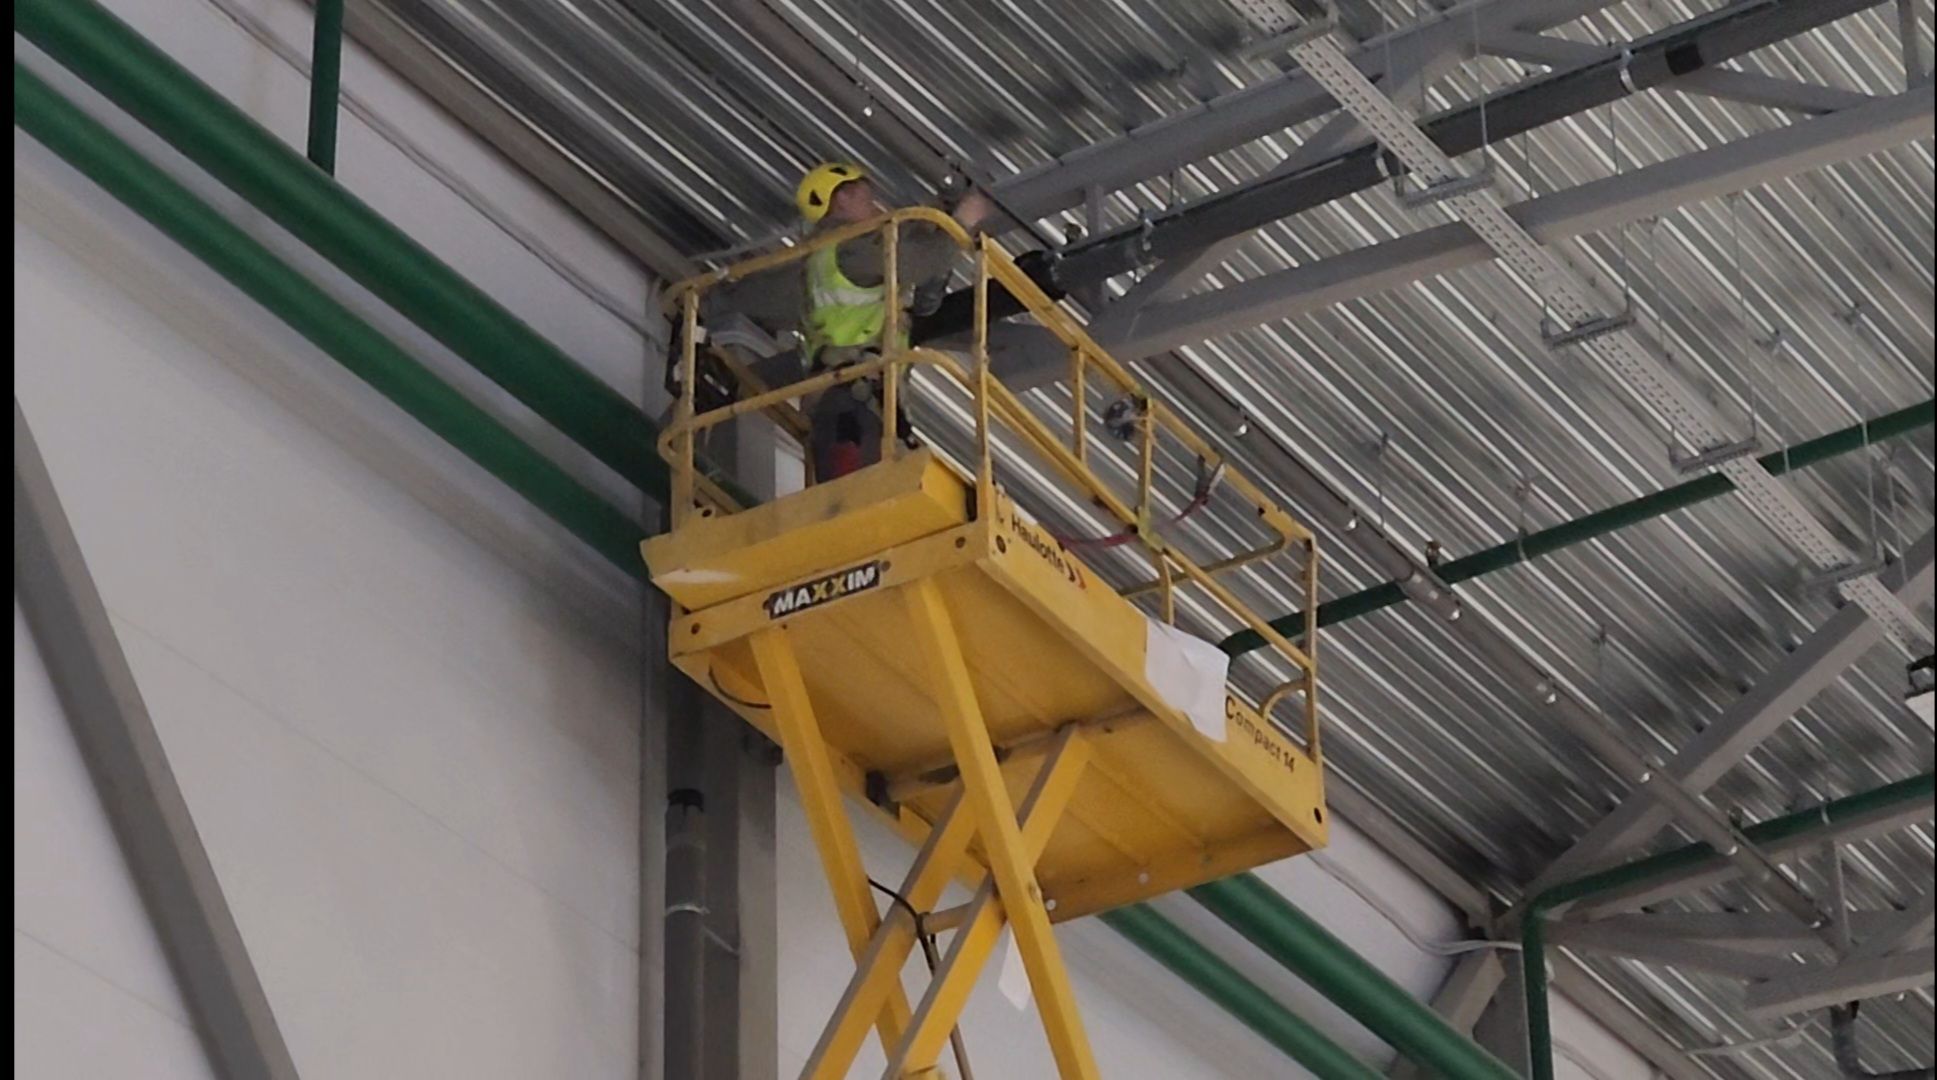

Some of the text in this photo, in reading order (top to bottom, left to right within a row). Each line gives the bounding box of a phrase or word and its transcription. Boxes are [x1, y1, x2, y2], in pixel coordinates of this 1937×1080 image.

[1012, 513, 1065, 574] Haulotte
[774, 566, 875, 614] MAXXIM
[1225, 695, 1295, 773] Compact 14
